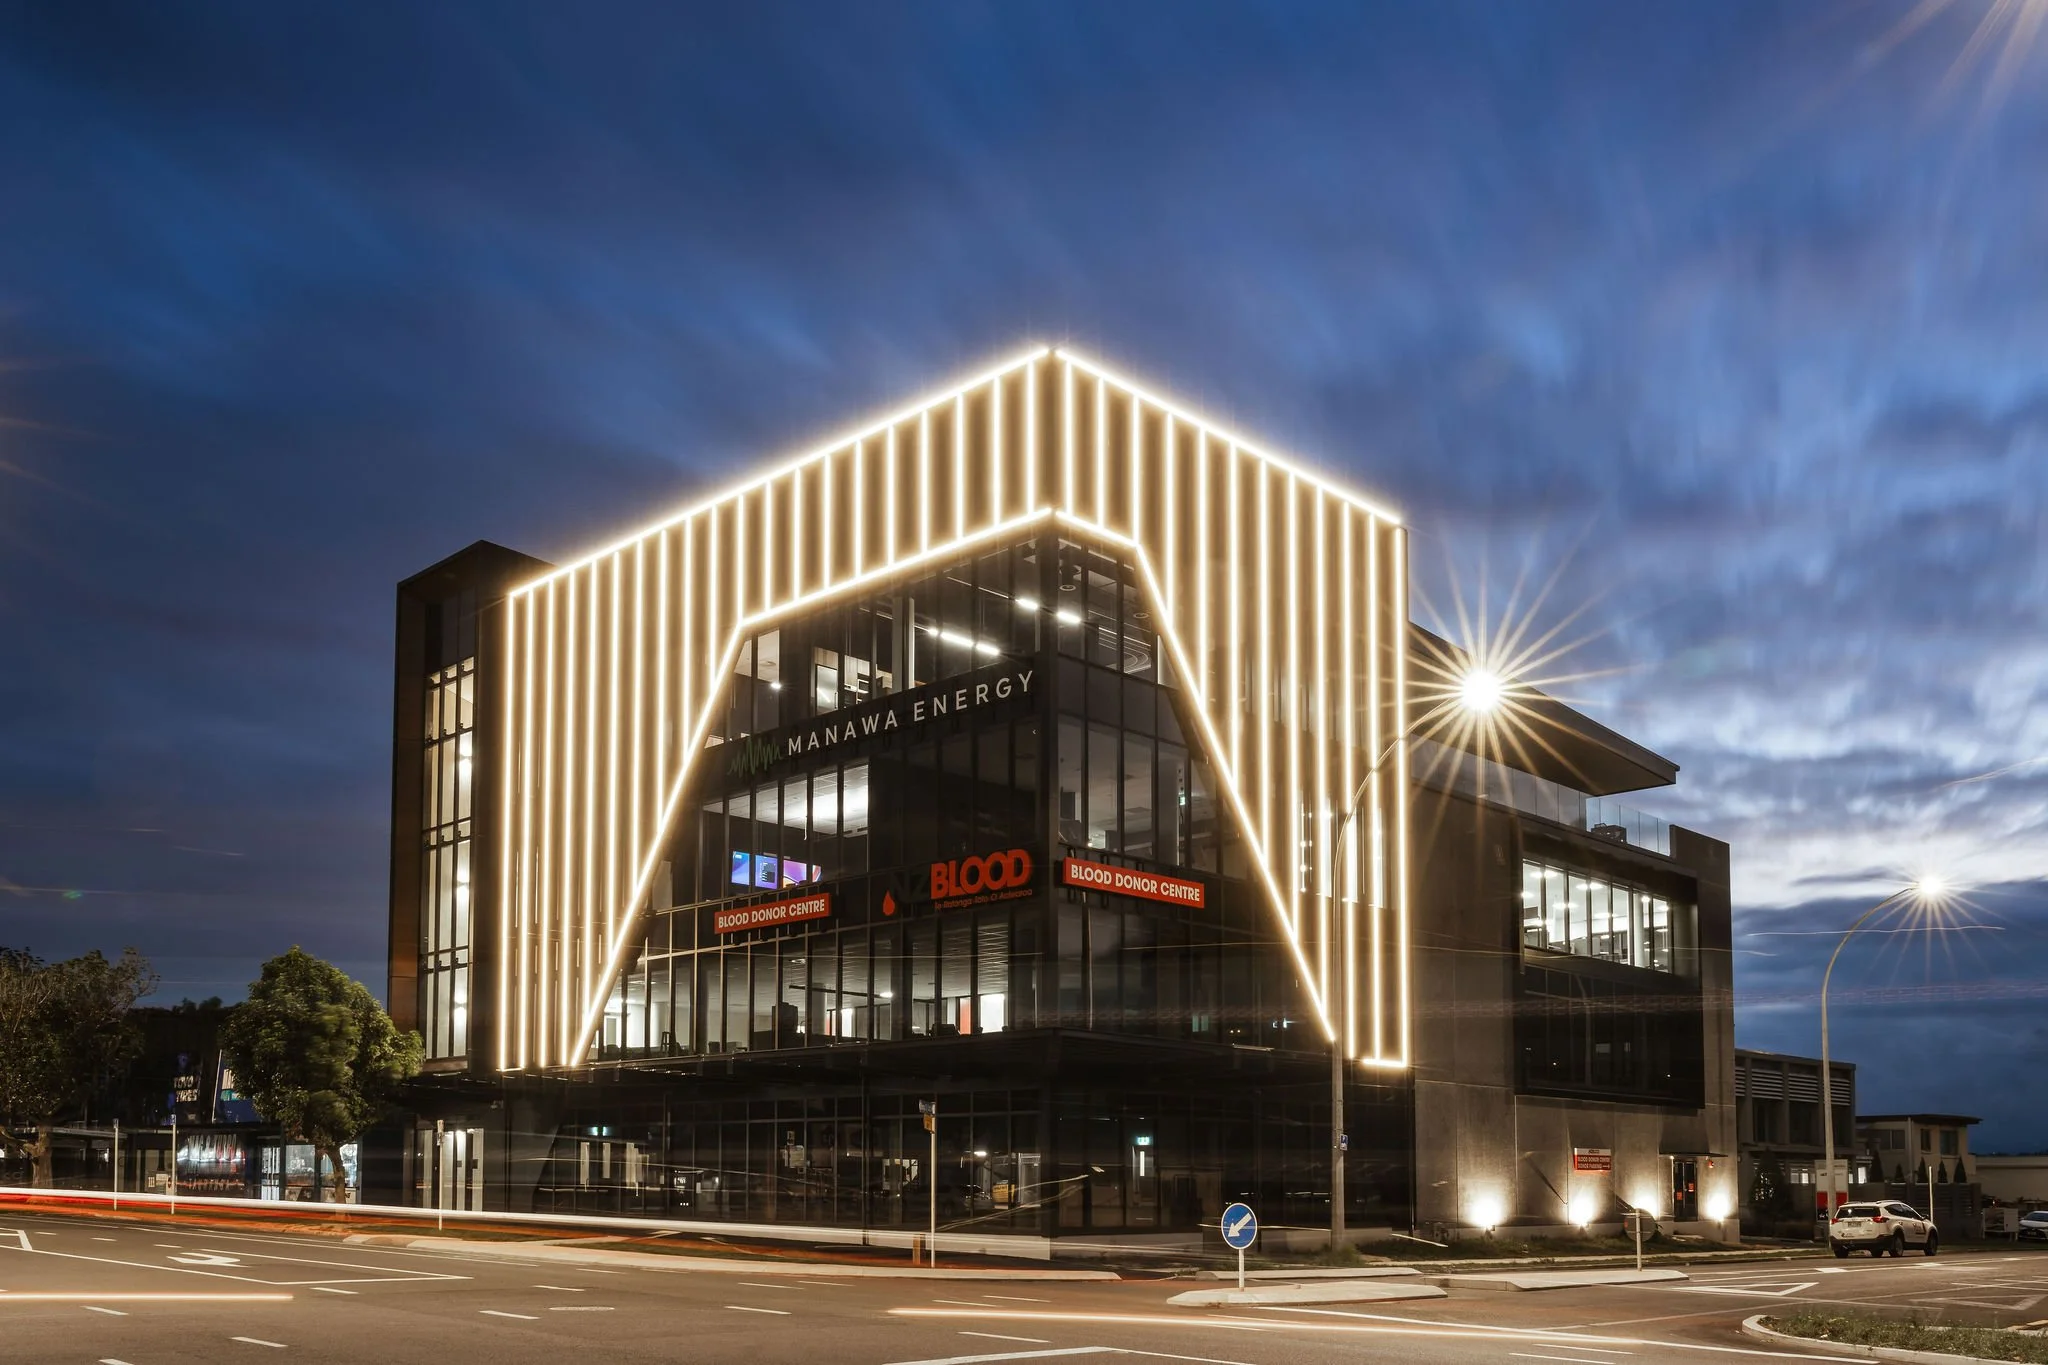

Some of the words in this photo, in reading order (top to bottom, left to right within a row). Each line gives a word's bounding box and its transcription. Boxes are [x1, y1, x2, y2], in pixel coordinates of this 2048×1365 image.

[788, 710, 898, 756] MANAWA
[913, 670, 1033, 722] ENERGY
[1071, 864, 1112, 885] BLOOD
[1115, 873, 1157, 894] DONOR
[1160, 882, 1200, 902] CENTRE
[718, 913, 749, 928] BLOOD
[751, 906, 786, 923] DONOR
[788, 899, 825, 916] CENTRE
